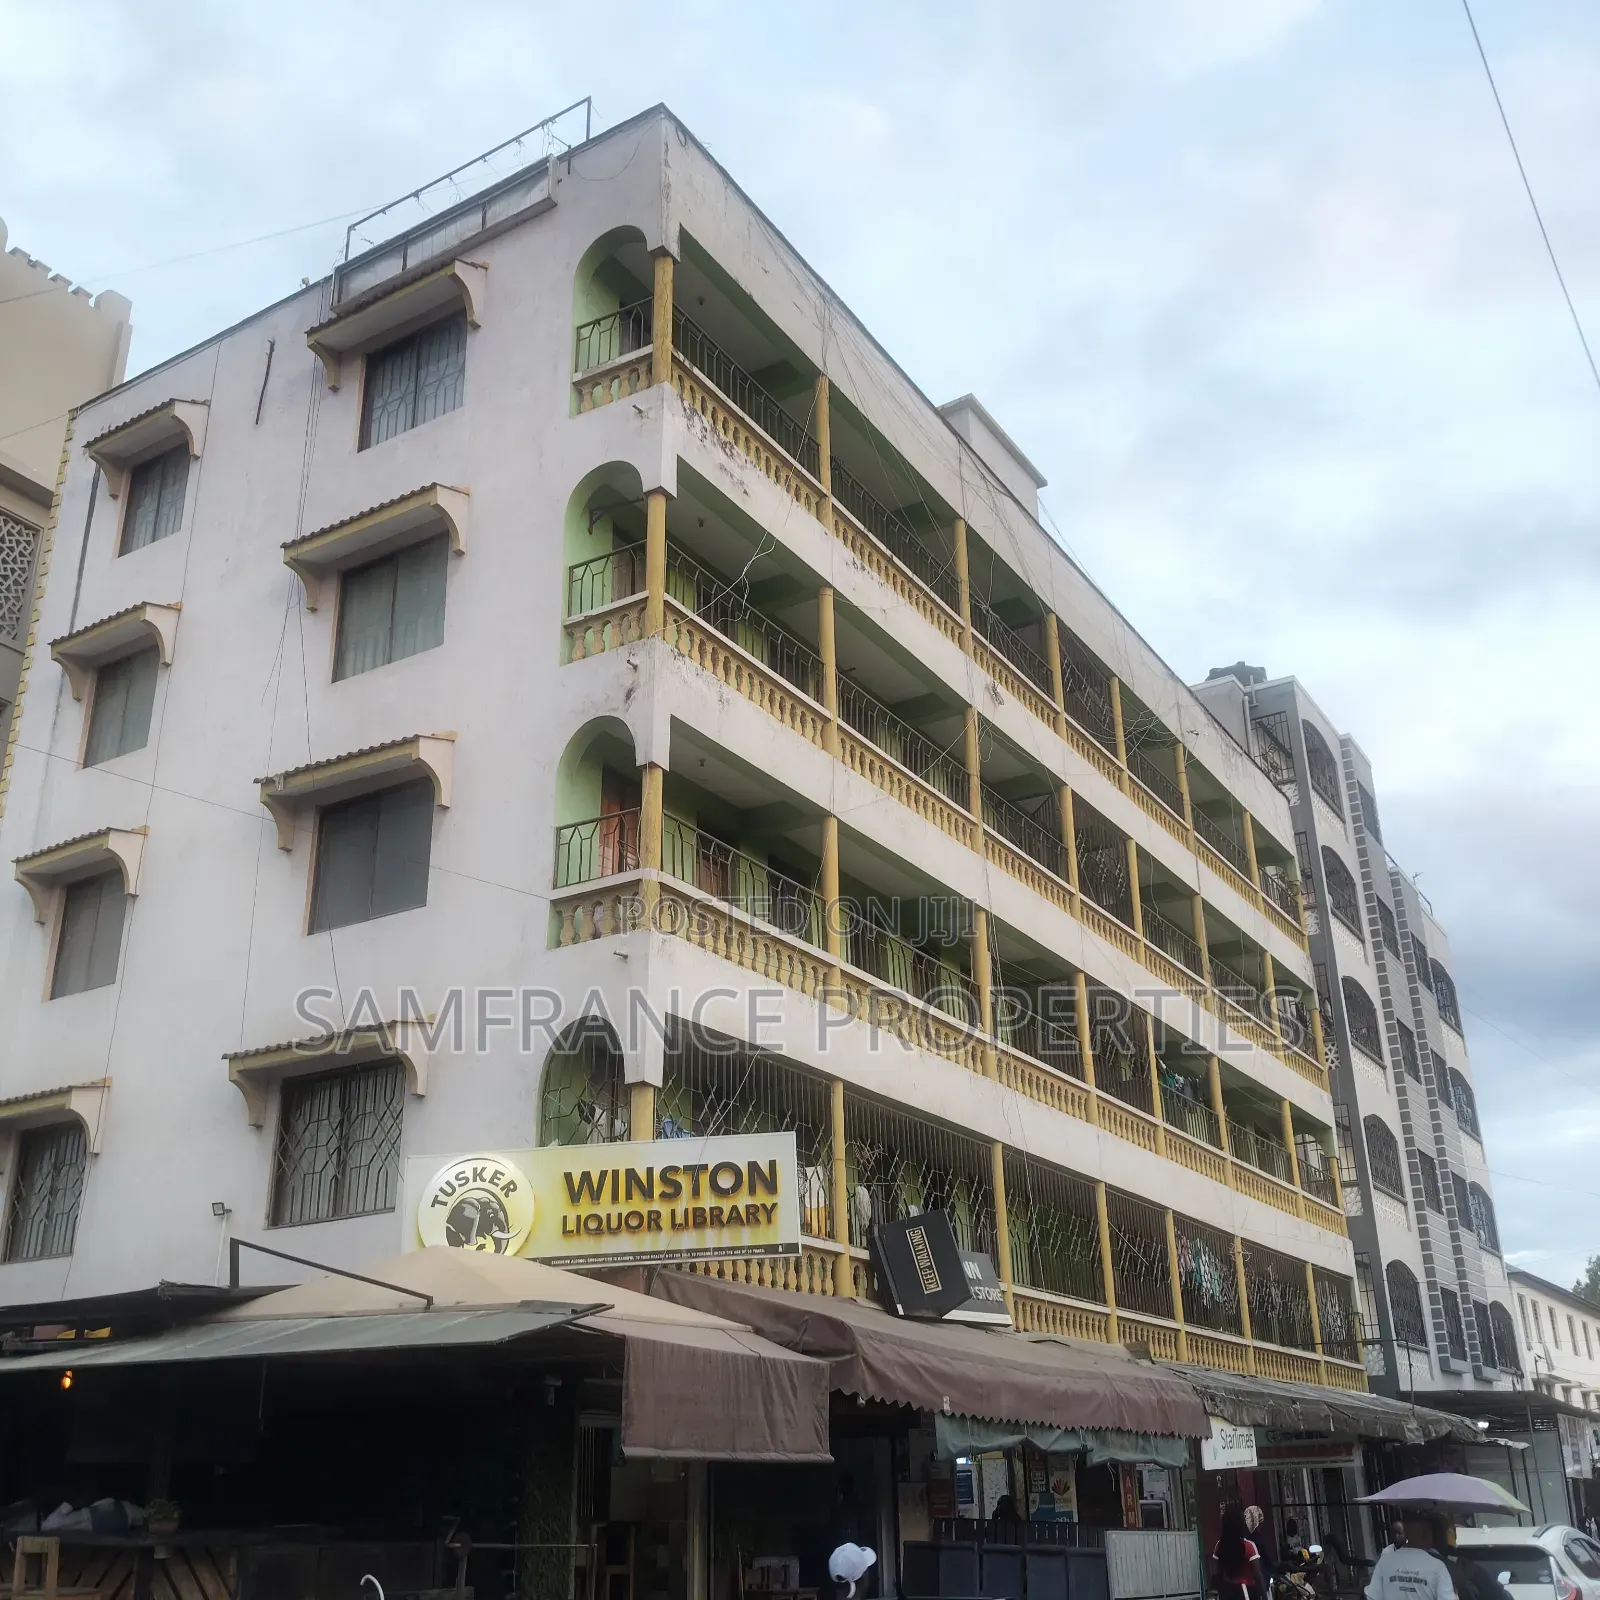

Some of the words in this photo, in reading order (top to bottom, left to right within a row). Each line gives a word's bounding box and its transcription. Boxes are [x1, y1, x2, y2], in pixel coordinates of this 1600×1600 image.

[430, 1166, 519, 1210] TUSKER
[563, 1159, 779, 1206] WINSTON
[561, 1208, 664, 1236] LIQUOR
[670, 1202, 779, 1231] LIBRARY
[909, 1229, 931, 1269] WALKING
[921, 1267, 939, 1290] KEEP
